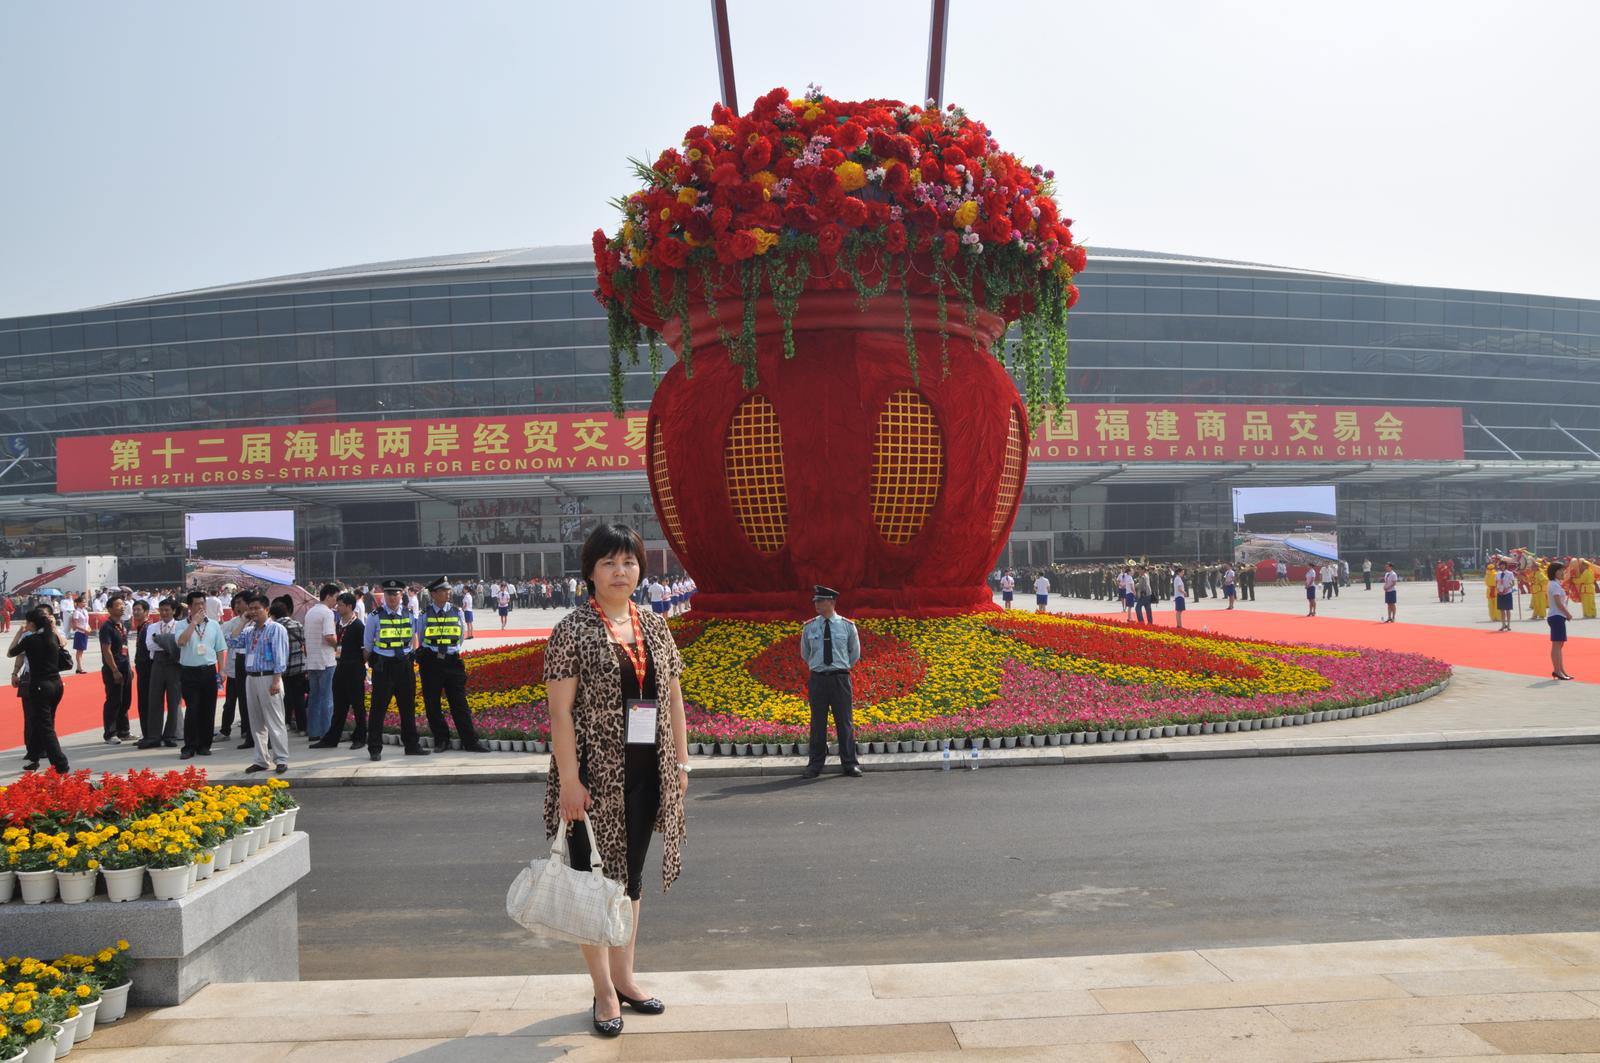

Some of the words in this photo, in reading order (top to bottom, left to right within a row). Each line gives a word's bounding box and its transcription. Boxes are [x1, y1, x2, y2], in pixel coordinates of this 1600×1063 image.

[1029, 408, 1403, 442] 国福建商品交易会
[110, 416, 647, 471] 第十二届海峡两岸经贸交易
[1169, 445, 1224, 457] FAIR
[1239, 445, 1325, 457] FUJIAN
[1337, 445, 1404, 457] CHINA
[110, 475, 143, 487] THE
[151, 472, 195, 486] 12TH
[202, 464, 363, 483] CROSS-STRAITS
[371, 462, 416, 475] FAIR
[424, 460, 463, 473] FOR
[471, 456, 577, 472] ECONOMY
[586, 455, 630, 467] AND
